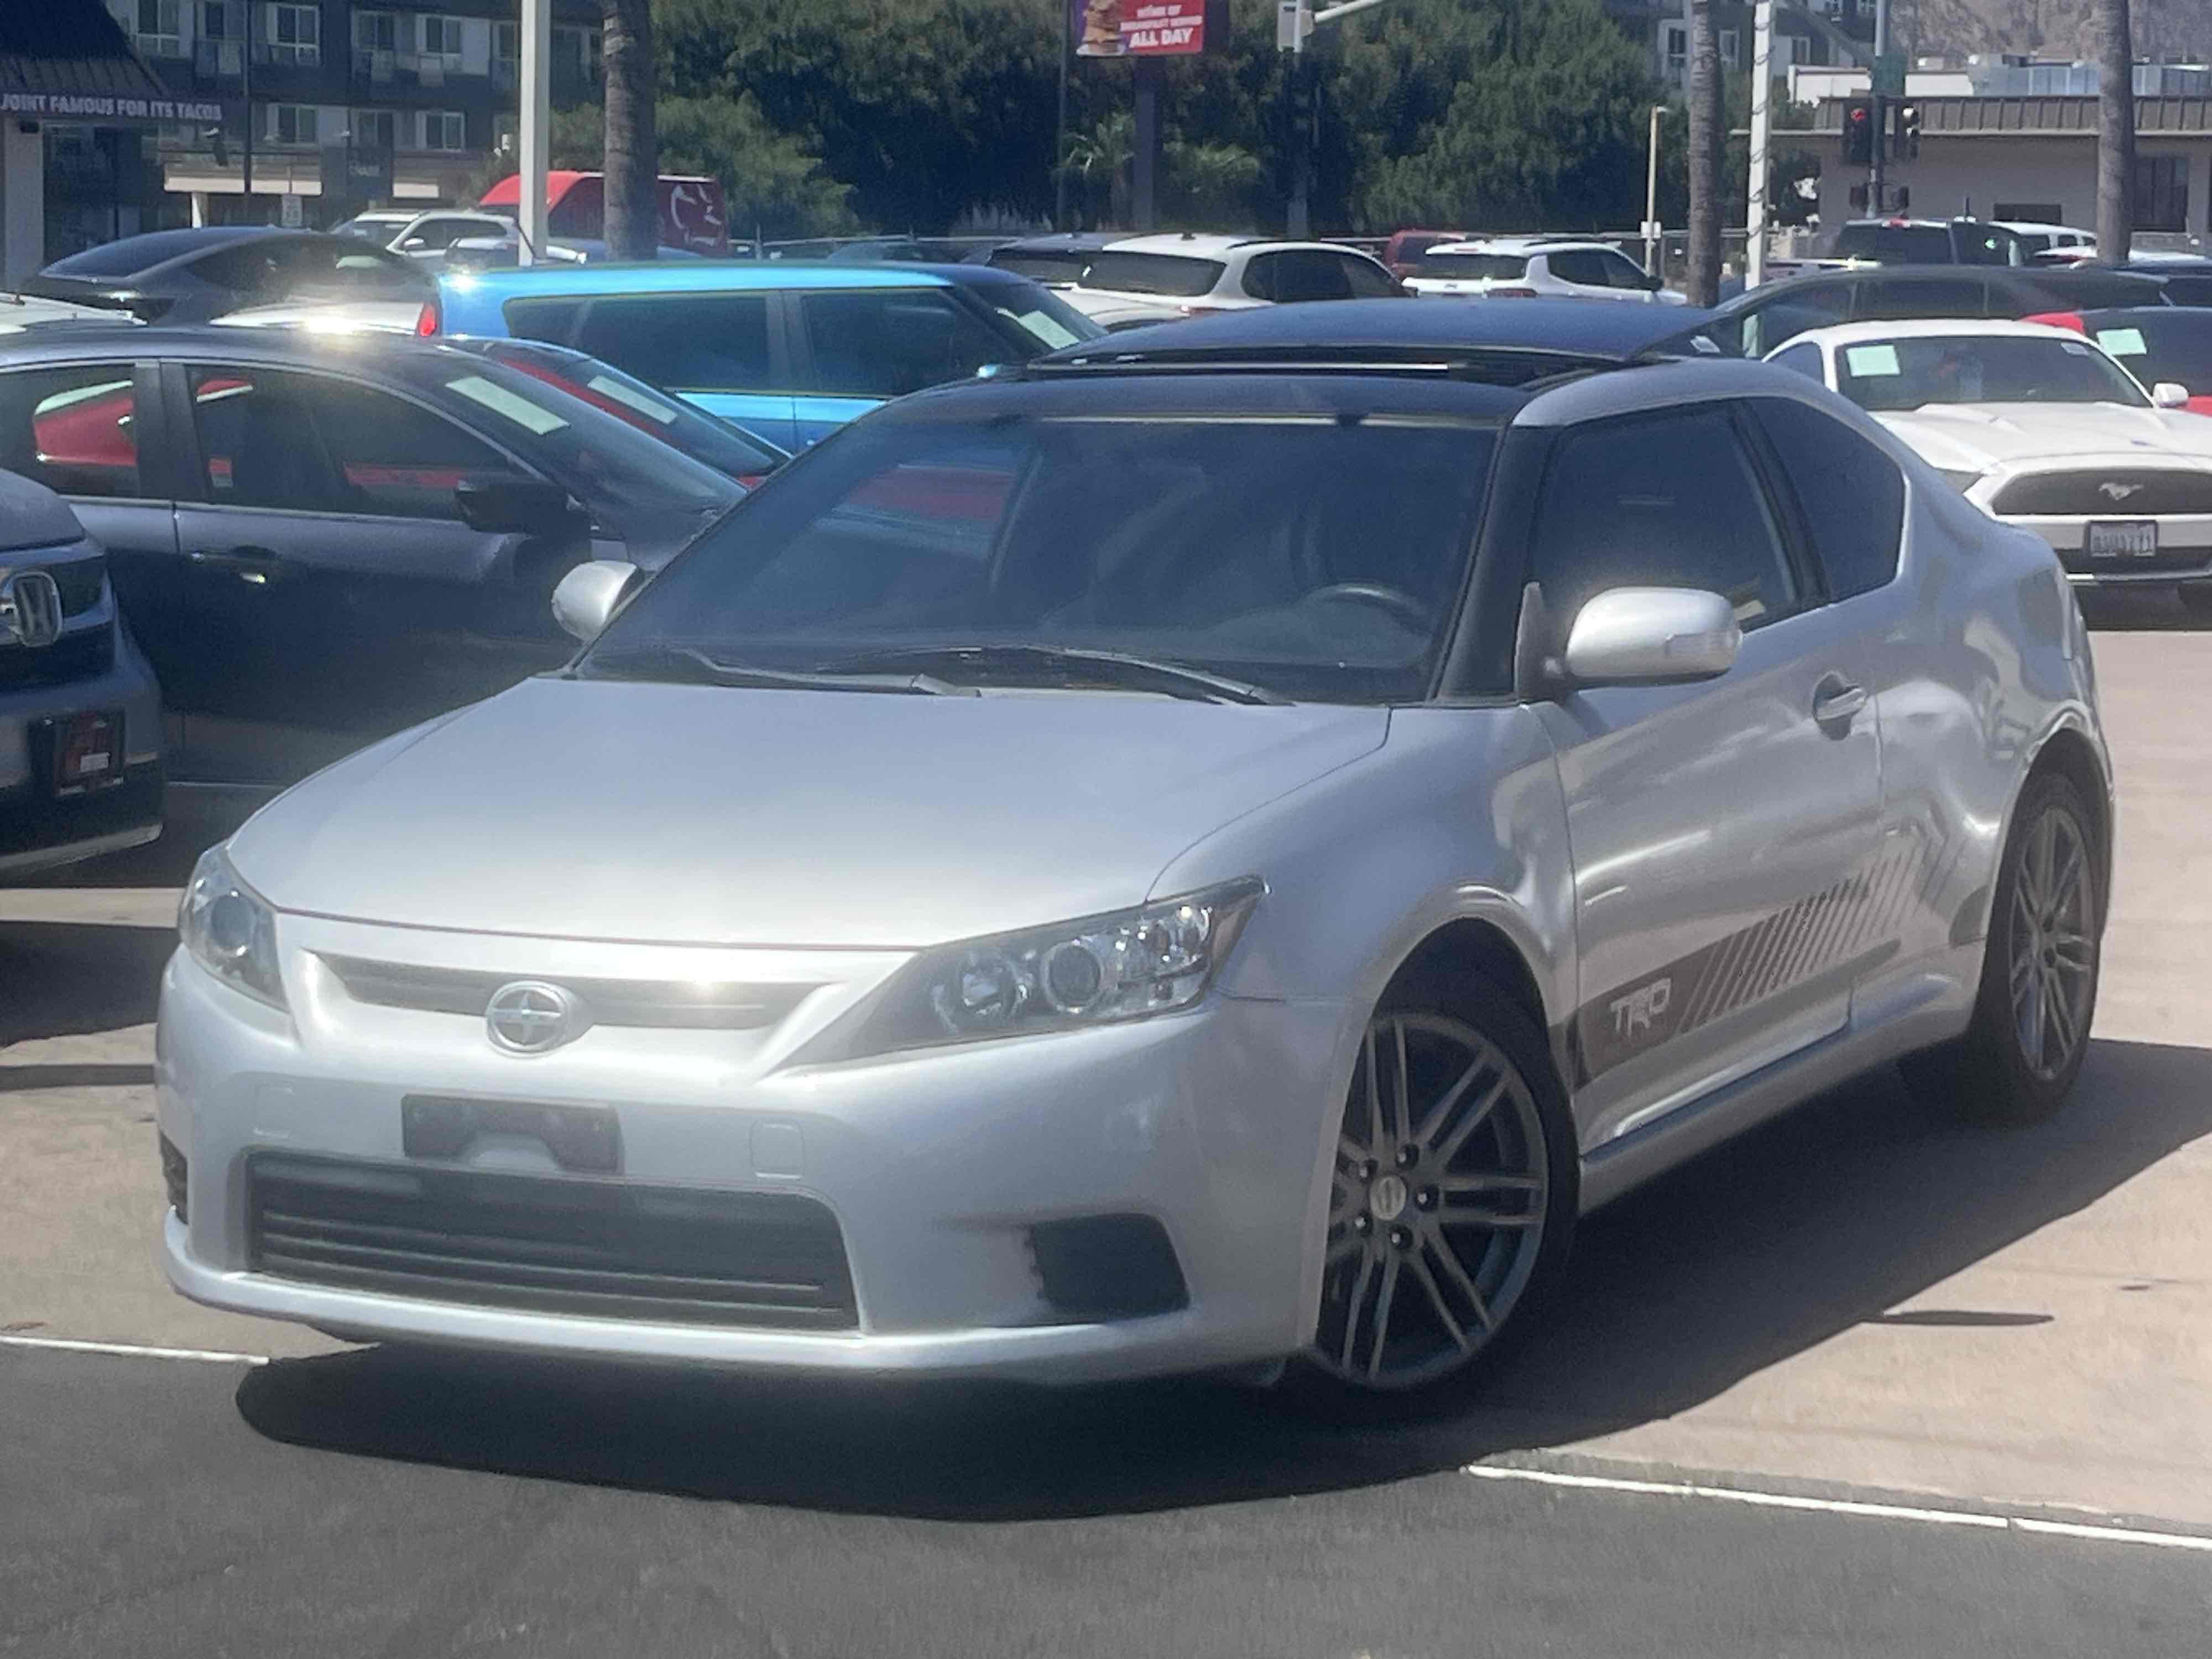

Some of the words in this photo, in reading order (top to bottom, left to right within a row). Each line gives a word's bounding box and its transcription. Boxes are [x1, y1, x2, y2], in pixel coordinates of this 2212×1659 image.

[1129, 31, 1159, 48] ALL
[1162, 28, 1194, 45] DAY
[0, 93, 46, 111] JOINT
[49, 96, 114, 115] FAMOUS
[117, 100, 147, 117] FOR
[150, 101, 173, 118] ITS
[176, 102, 222, 121] TACOS
[1610, 977, 1671, 1036] TRD
